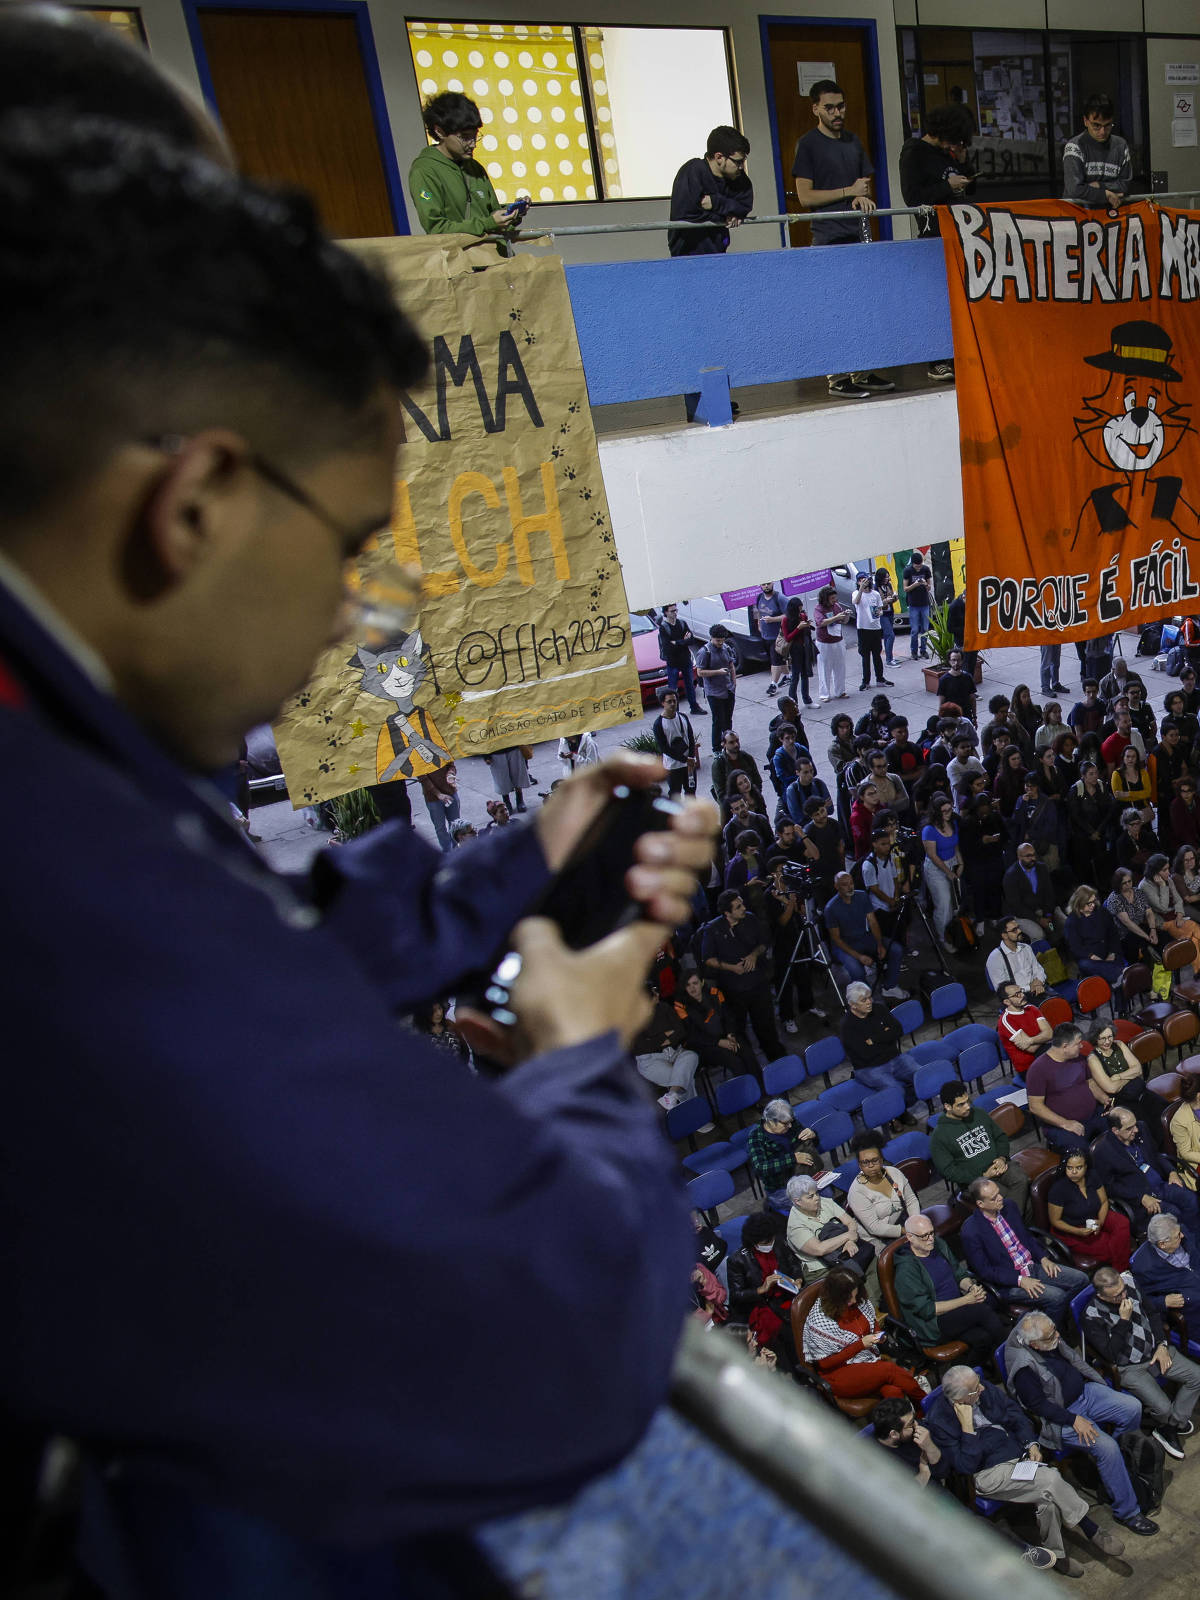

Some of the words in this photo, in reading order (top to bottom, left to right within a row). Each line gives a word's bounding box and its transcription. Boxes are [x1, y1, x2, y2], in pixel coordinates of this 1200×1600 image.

[951, 203, 1151, 302] BATERIA
[399, 330, 545, 444] MA
[977, 574, 1089, 633] PORQUE
[1100, 554, 1124, 624] É
[1131, 538, 1199, 612] FÁCIL
[455, 613, 626, 686] @fflch2025
[571, 706, 585, 718] DE
[593, 695, 633, 713] BECAS
